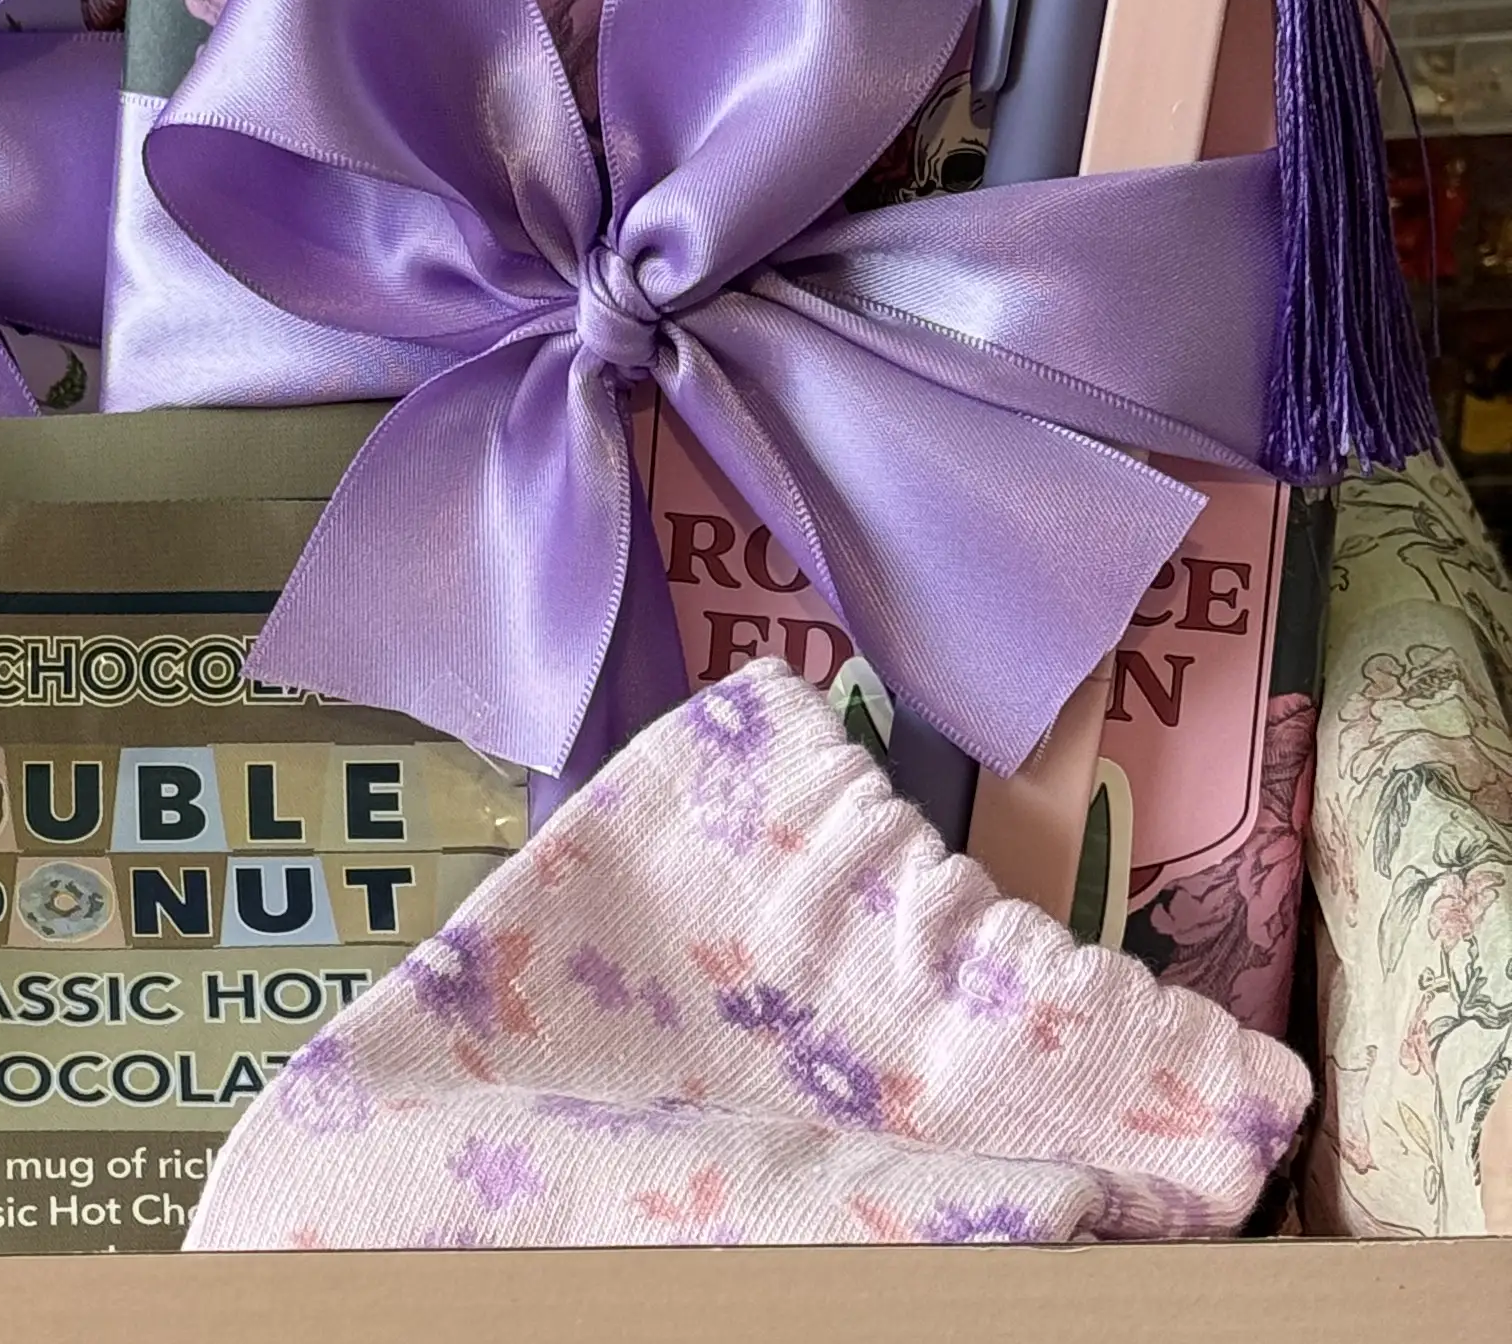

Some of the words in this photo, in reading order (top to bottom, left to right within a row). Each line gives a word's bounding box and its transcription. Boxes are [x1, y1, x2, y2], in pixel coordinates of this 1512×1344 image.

[202, 969, 372, 1024] HOT
[6, 1155, 94, 1187] mug
[107, 1147, 148, 1180] of
[50, 1195, 121, 1226] Hot
